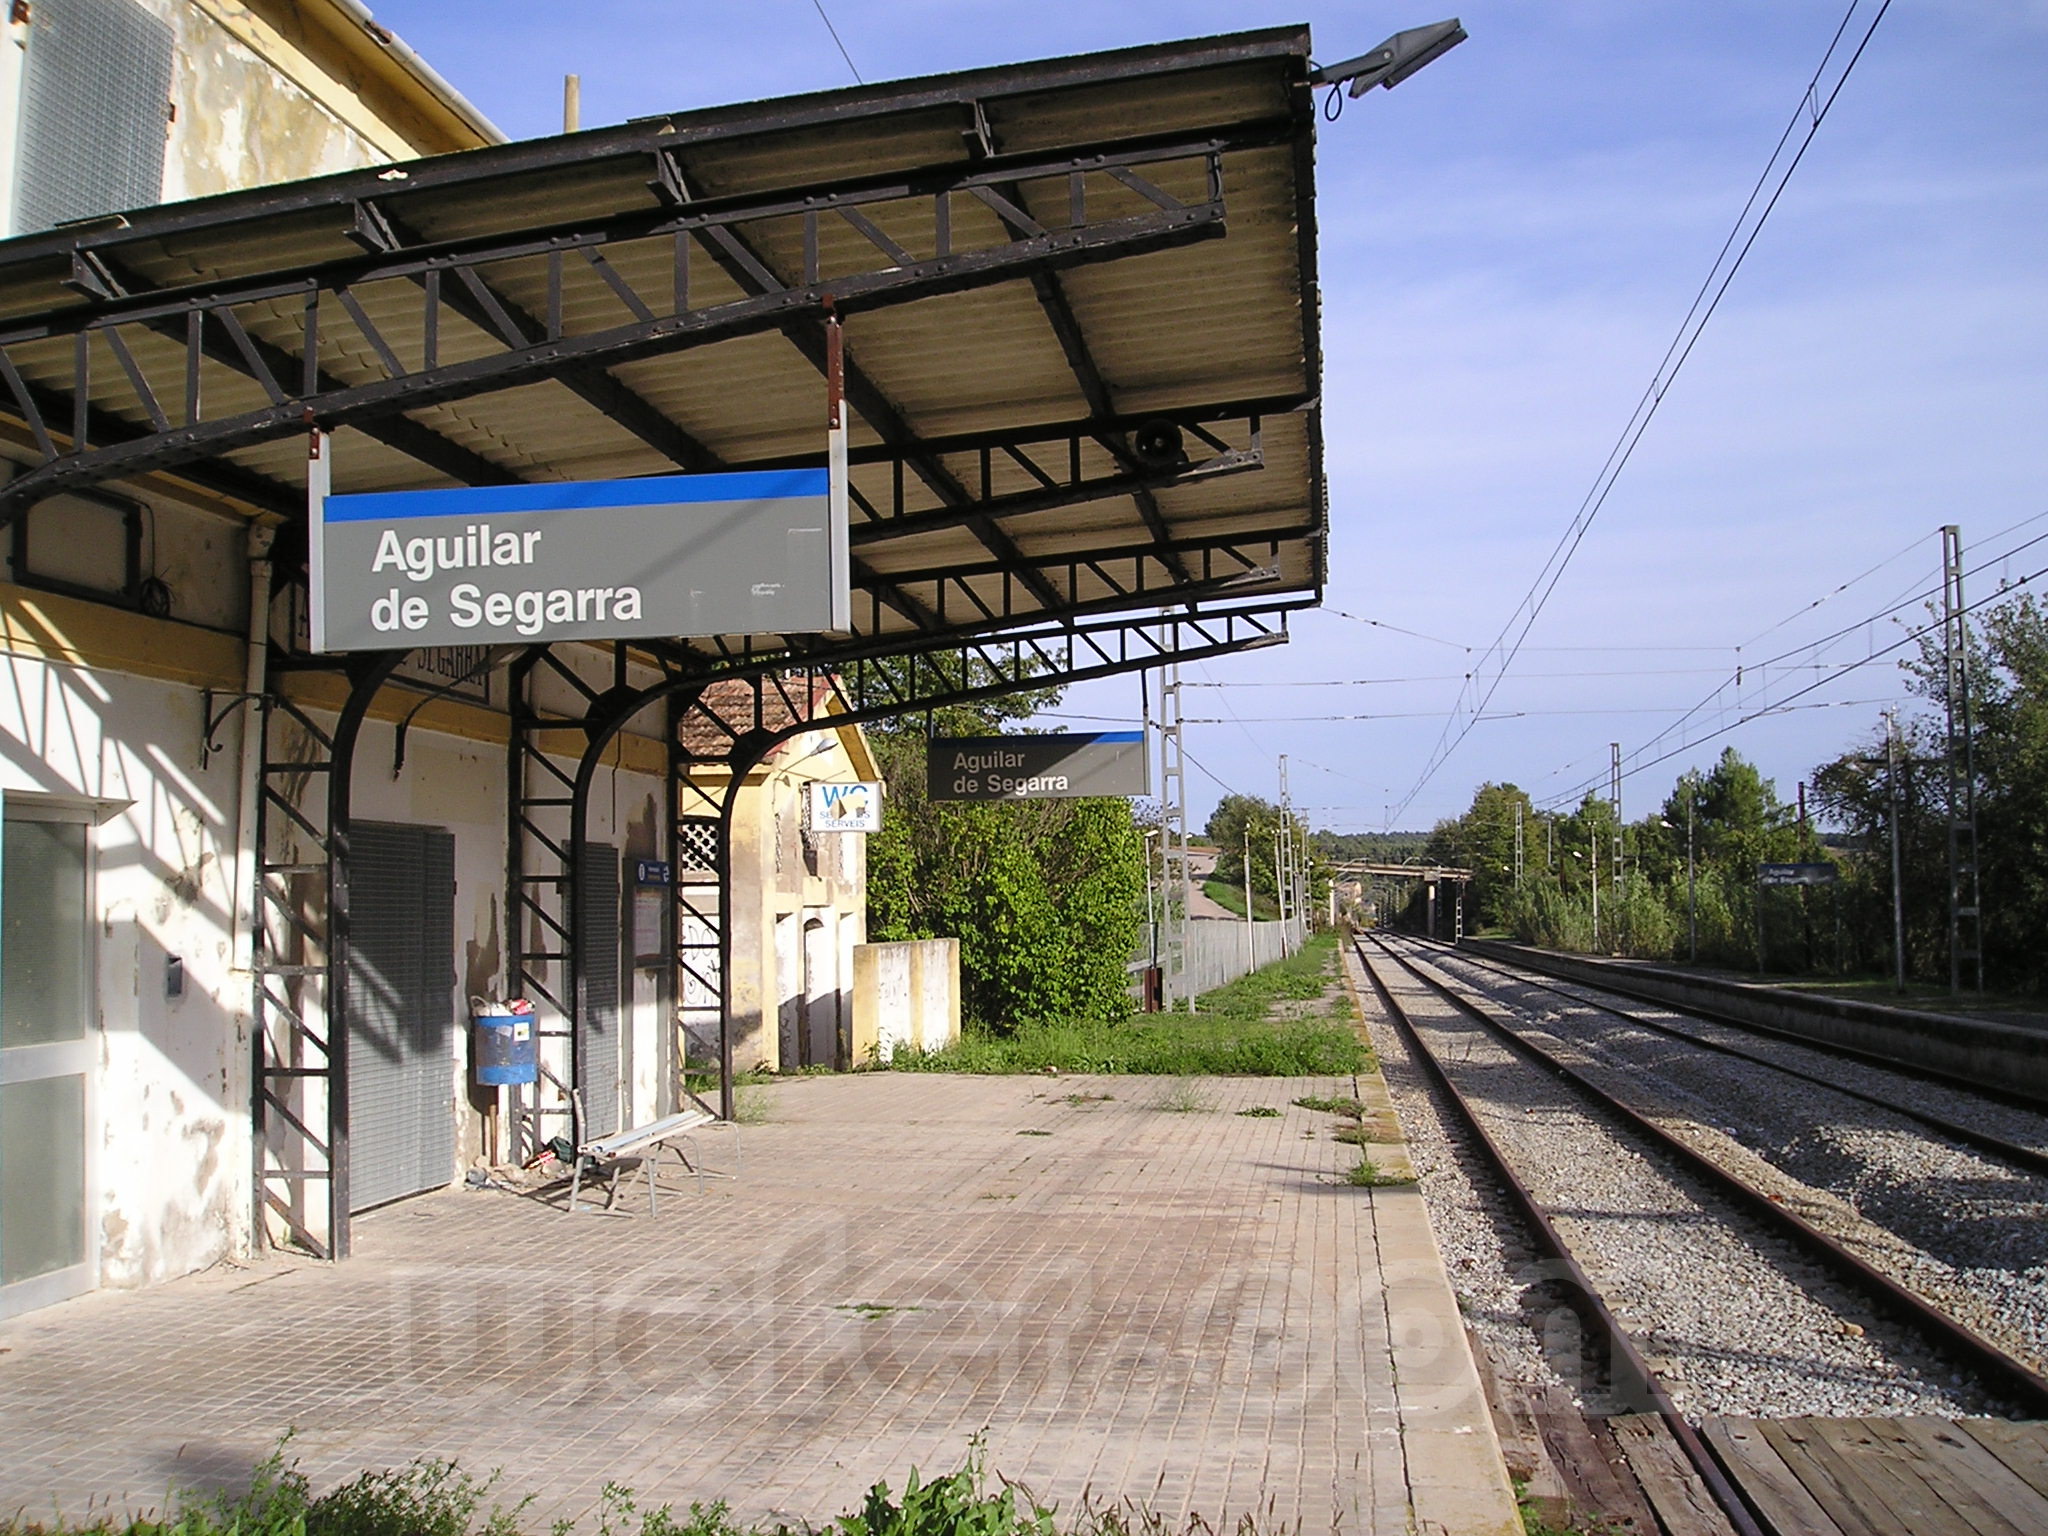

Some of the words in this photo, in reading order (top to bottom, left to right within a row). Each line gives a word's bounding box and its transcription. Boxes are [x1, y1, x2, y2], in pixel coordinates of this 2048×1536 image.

[372, 524, 542, 582] Aguilar
[371, 588, 429, 632] de
[450, 583, 643, 635] Segarra
[953, 751, 1025, 773] Aguilar
[953, 776, 979, 794] de
[987, 773, 1069, 796] Segarra
[825, 819, 865, 828] SERVEIS
